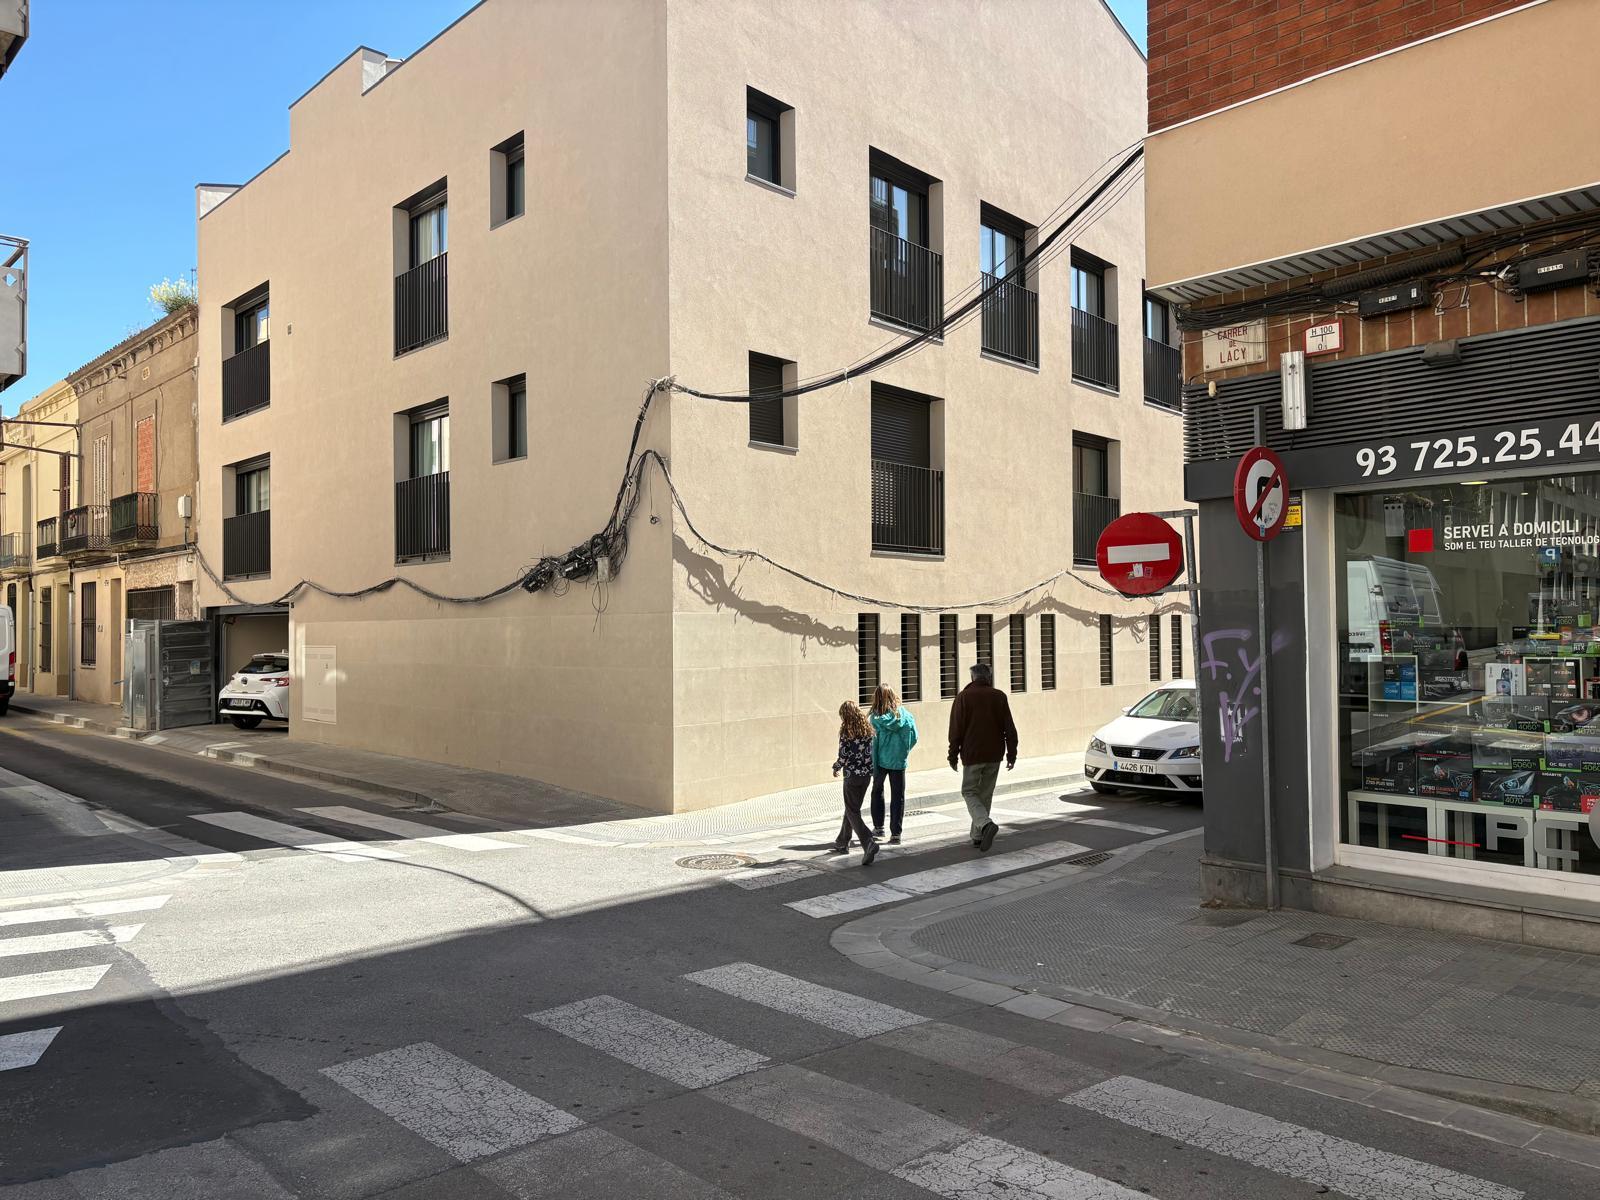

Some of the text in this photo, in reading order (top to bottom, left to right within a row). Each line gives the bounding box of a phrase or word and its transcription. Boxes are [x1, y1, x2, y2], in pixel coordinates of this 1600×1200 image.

[1217, 325, 1248, 340] CARRER
[1320, 325, 1334, 334] 100
[1220, 348, 1247, 364] LACY
[1356, 421, 1600, 477] 93 725.25.44
[1443, 519, 1579, 539] SERVEI A DOMICILI
[1444, 535, 1600, 551] SOM EL TEU TALLER DE TECNOLOG
[1139, 764, 1154, 773] KTN
